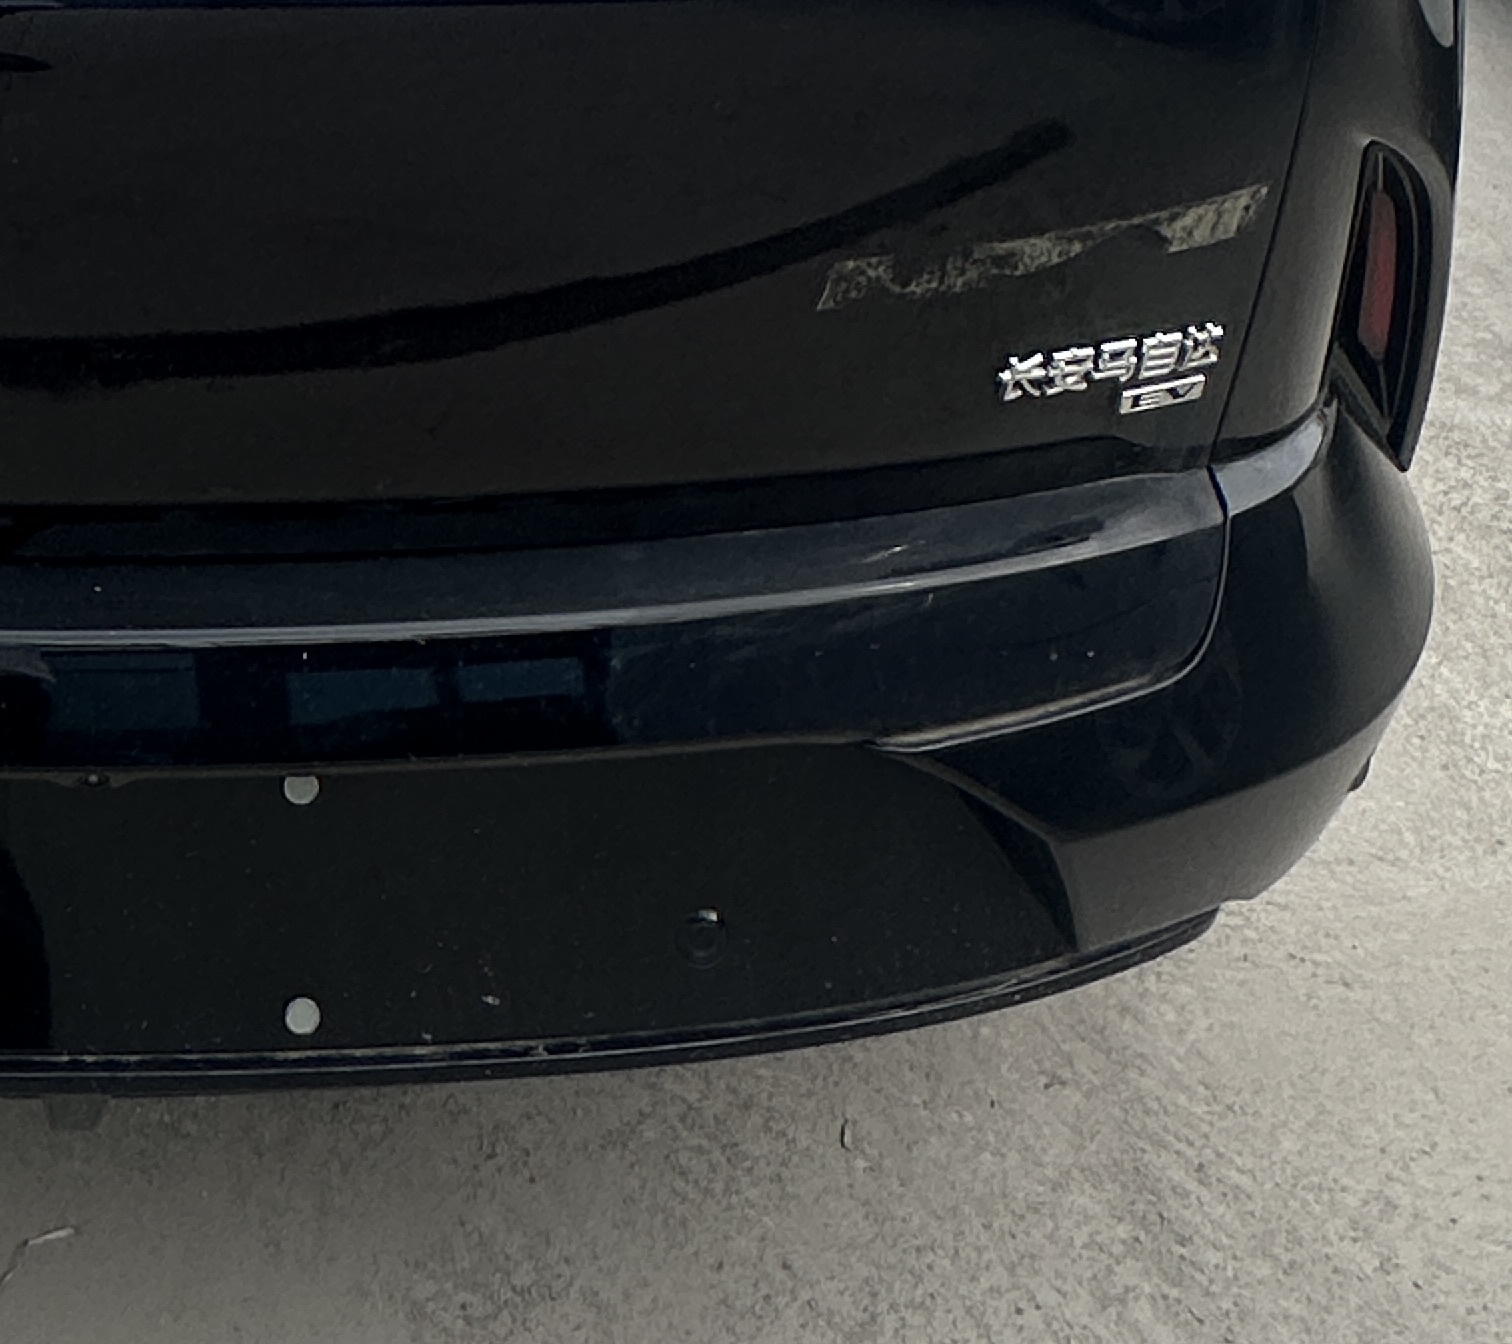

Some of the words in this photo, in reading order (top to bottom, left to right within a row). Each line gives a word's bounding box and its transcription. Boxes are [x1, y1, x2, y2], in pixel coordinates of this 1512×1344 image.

[998, 321, 1225, 402] 长安马自达
[1128, 380, 1200, 410] EV
